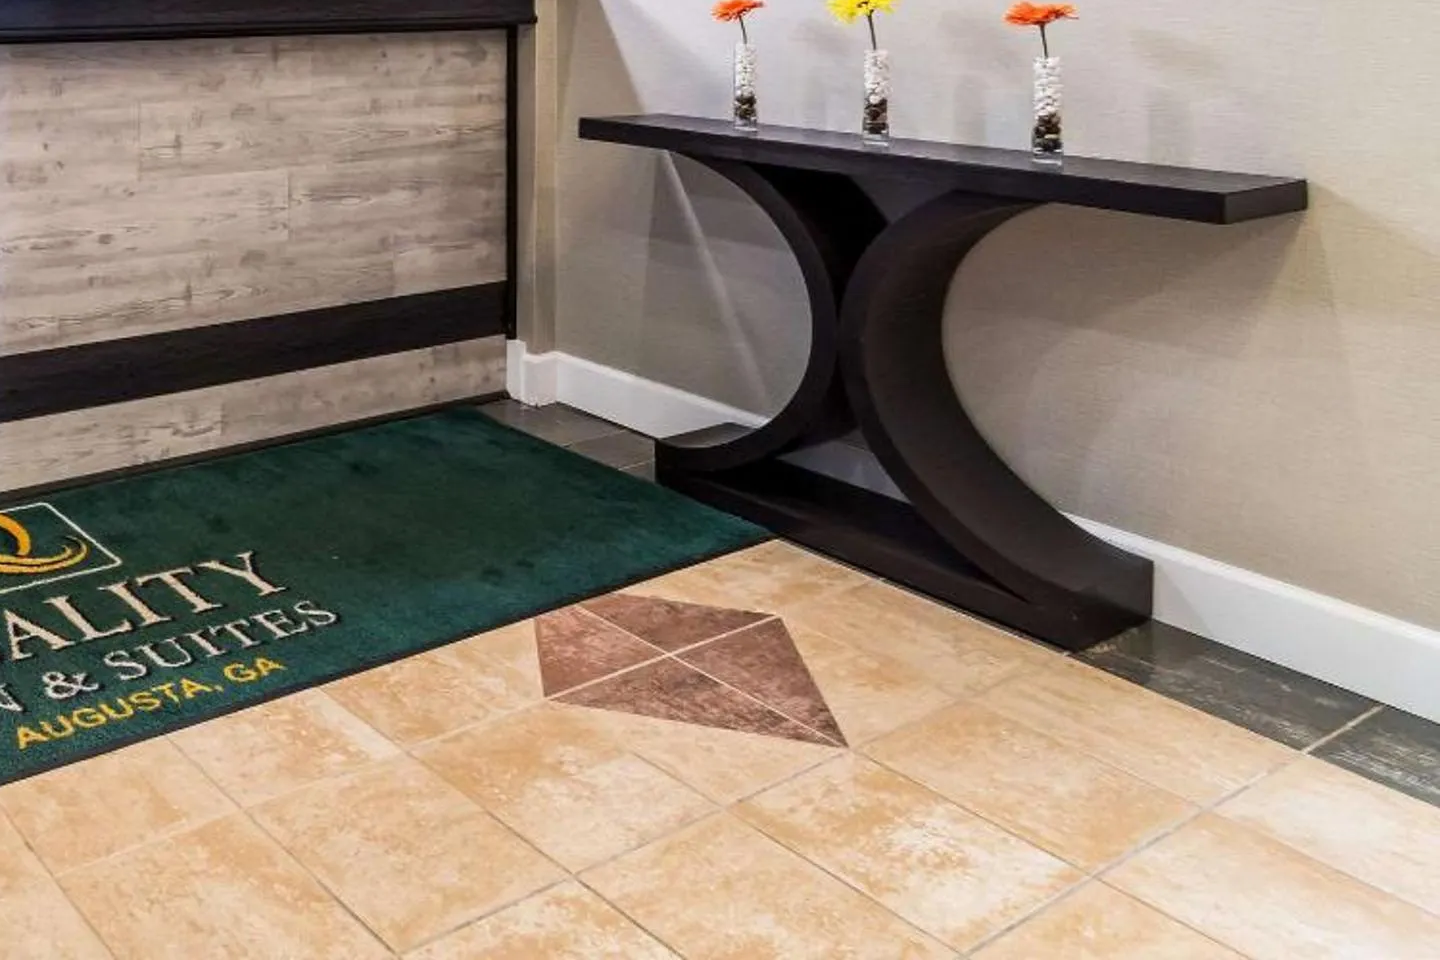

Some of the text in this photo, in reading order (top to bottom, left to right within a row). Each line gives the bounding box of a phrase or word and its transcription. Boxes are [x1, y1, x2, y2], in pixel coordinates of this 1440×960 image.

[42, 670, 100, 701] &
[103, 599, 339, 682] SUITES
[16, 655, 287, 751] AUGUSTA, GA
